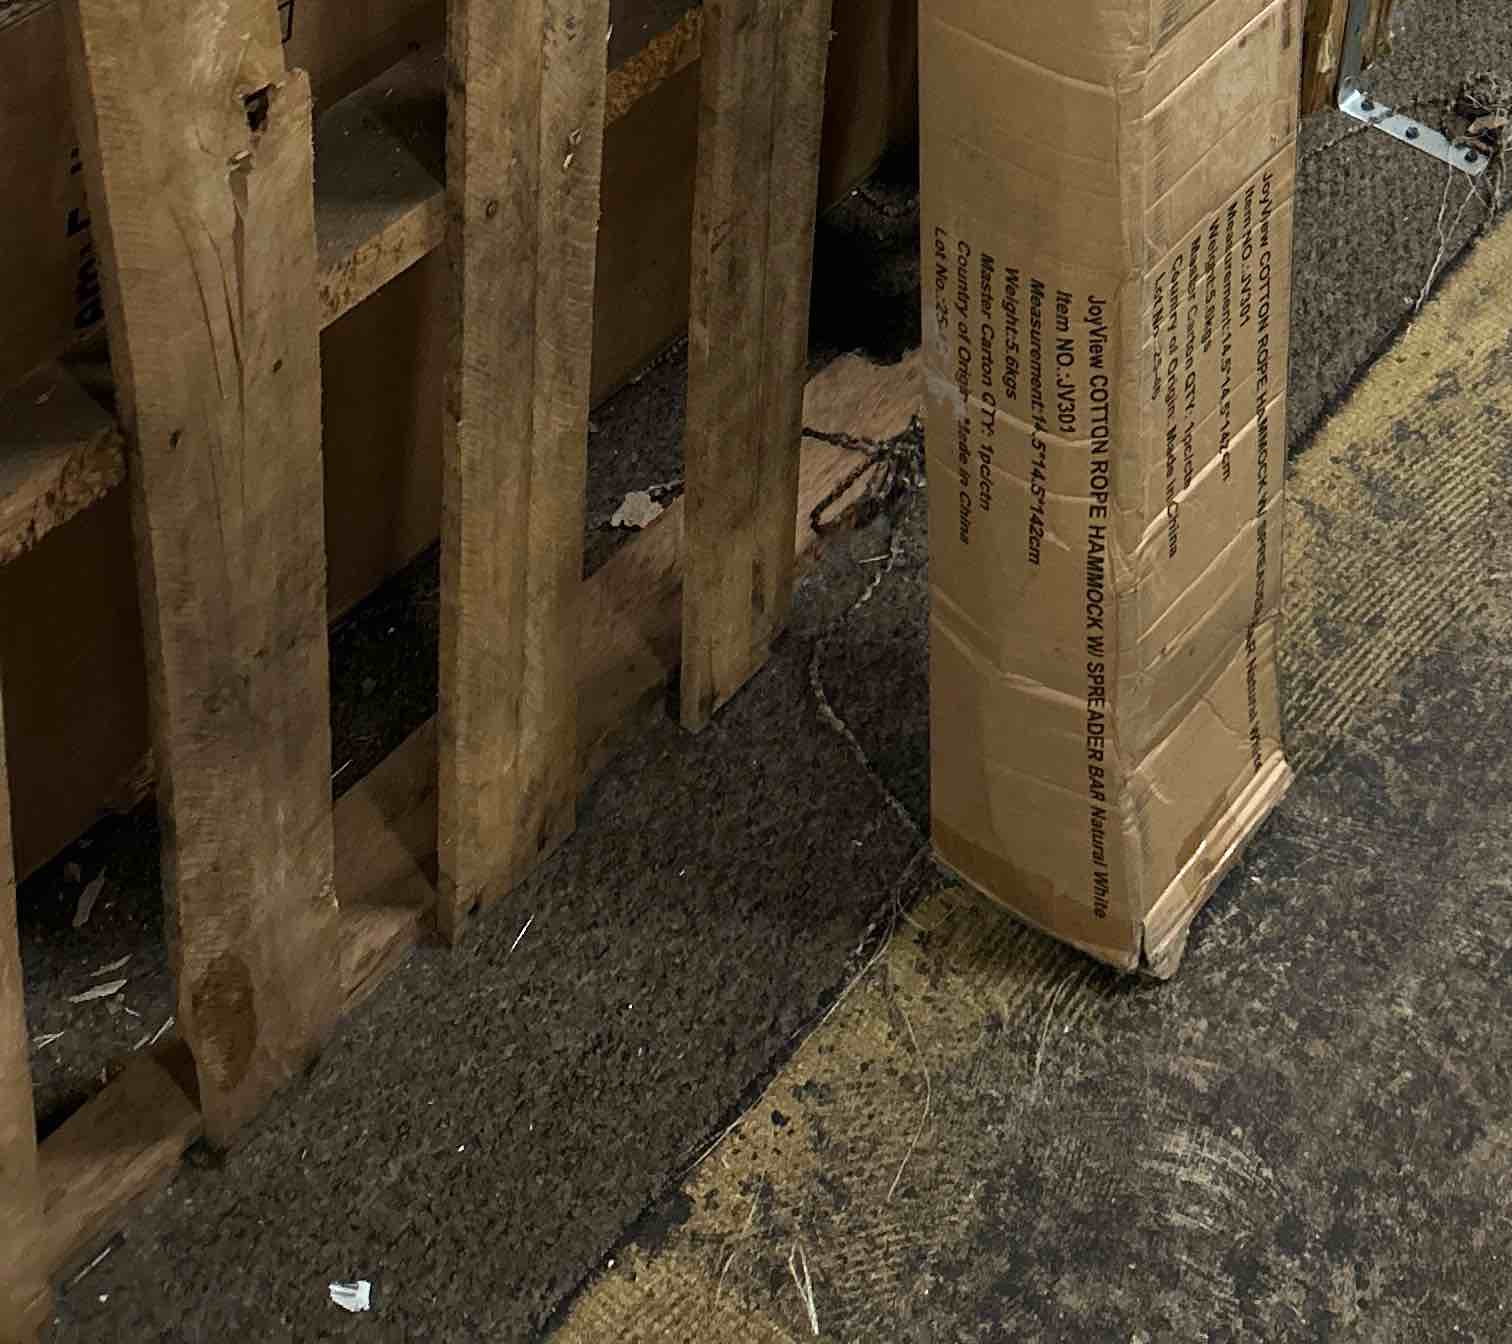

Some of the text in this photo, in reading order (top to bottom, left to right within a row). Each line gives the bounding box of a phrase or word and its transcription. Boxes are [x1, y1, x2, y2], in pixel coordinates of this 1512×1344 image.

[1244, 185, 1256, 229] Item
[1259, 173, 1273, 247] JoyView
[935, 226, 947, 259] Lot
[1187, 235, 1201, 300] Master
[955, 240, 971, 319] Country
[1153, 272, 1166, 303] Lot
[1168, 255, 1183, 332] Country
[1258, 251, 1272, 332] COTTON
[957, 321, 971, 344] of
[1056, 290, 1077, 433] Item NO.:JV301
[1168, 336, 1177, 355] of
[1185, 305, 1198, 370] Carton
[978, 253, 997, 512] Master Carton QTY: 1pc/ctn
[1257, 333, 1270, 391] ROPE
[1166, 425, 1177, 478] Made
[1256, 392, 1269, 488] HAMMOCK
[959, 466, 970, 487] in
[1166, 479, 1177, 502] in
[959, 490, 972, 545] China
[1167, 501, 1180, 559] China
[1084, 294, 1109, 919] JoyView COTTON ROPE HAMMOCK W/ SPREADER BAR Natural White
